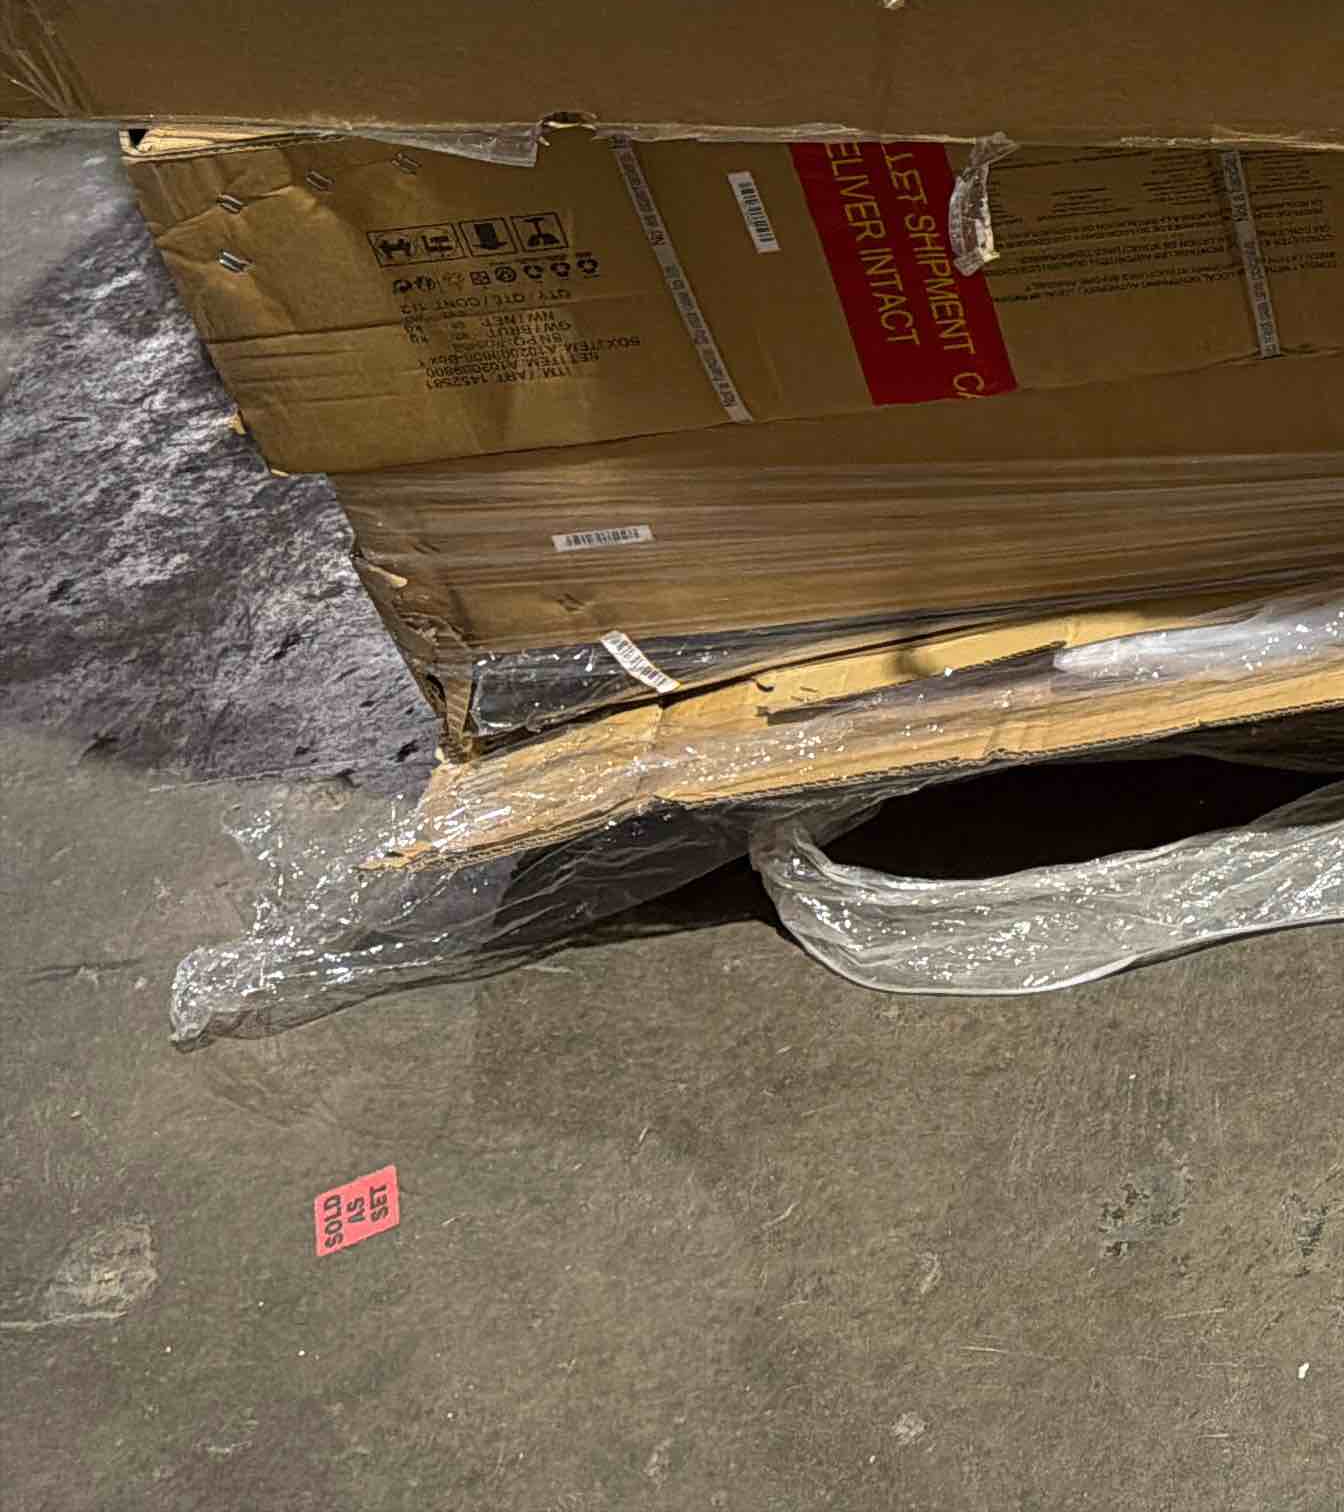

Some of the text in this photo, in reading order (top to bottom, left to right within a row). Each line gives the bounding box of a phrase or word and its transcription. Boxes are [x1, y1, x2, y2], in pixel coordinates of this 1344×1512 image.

[858, 247, 921, 346] INTACT
[904, 212, 977, 356] SHIPMENT
[324, 1194, 343, 1248] SOLD
[346, 1196, 366, 1224] AS
[370, 1184, 389, 1223] SET
